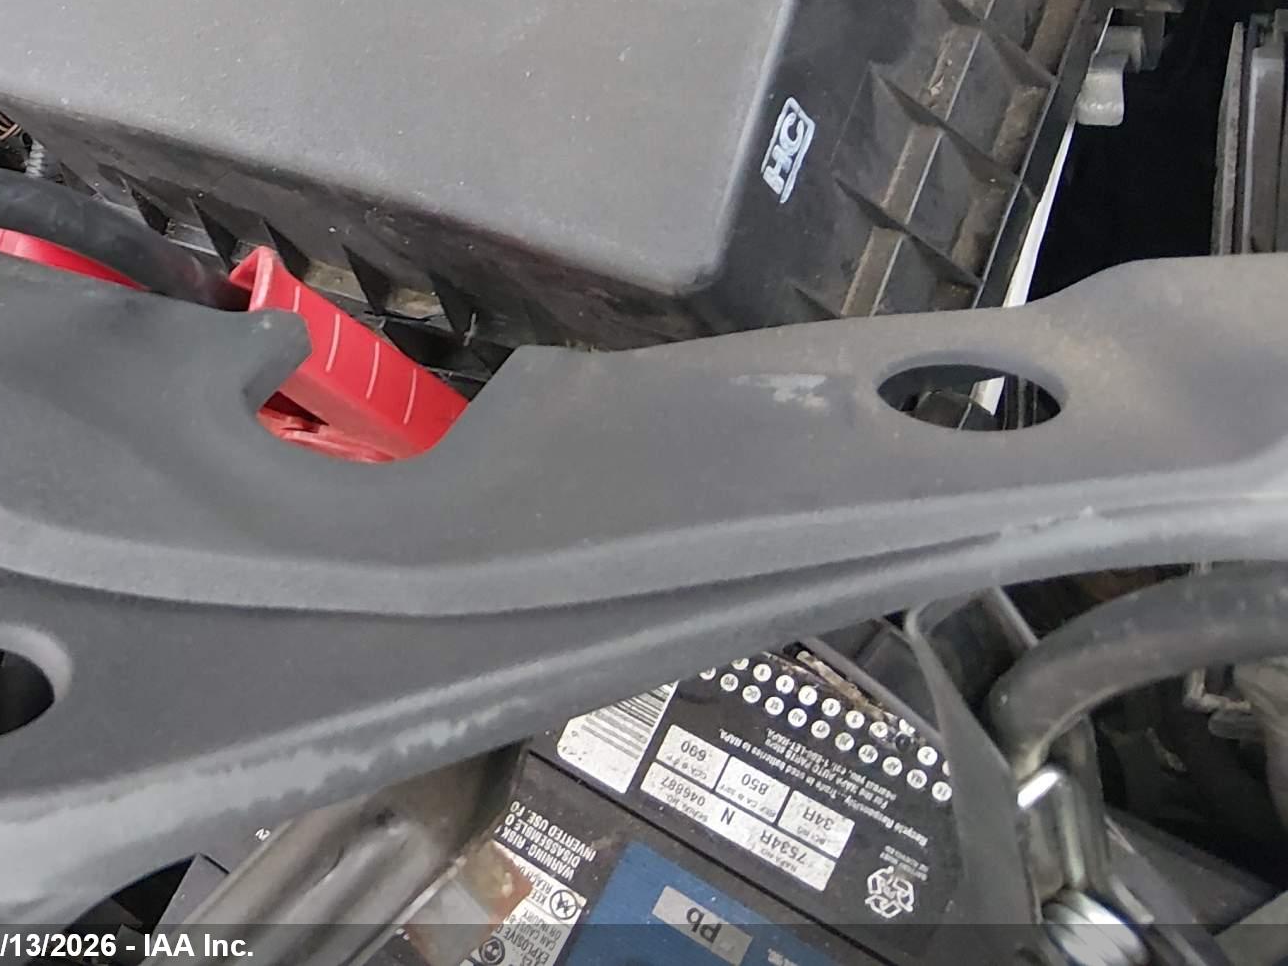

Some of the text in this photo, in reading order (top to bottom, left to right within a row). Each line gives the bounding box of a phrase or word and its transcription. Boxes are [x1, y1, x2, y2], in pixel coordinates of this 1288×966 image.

[739, 772, 770, 797] 850
[719, 807, 736, 826] N
[801, 806, 835, 832] 34R
[500, 826, 527, 850] RISK
[513, 817, 582, 870] DISASSEMBLE
[547, 822, 598, 863] INVERTED
[758, 829, 810, 865] 7534R
[679, 905, 725, 944] Pb
[501, 927, 552, 965] EXPLOSIVE
